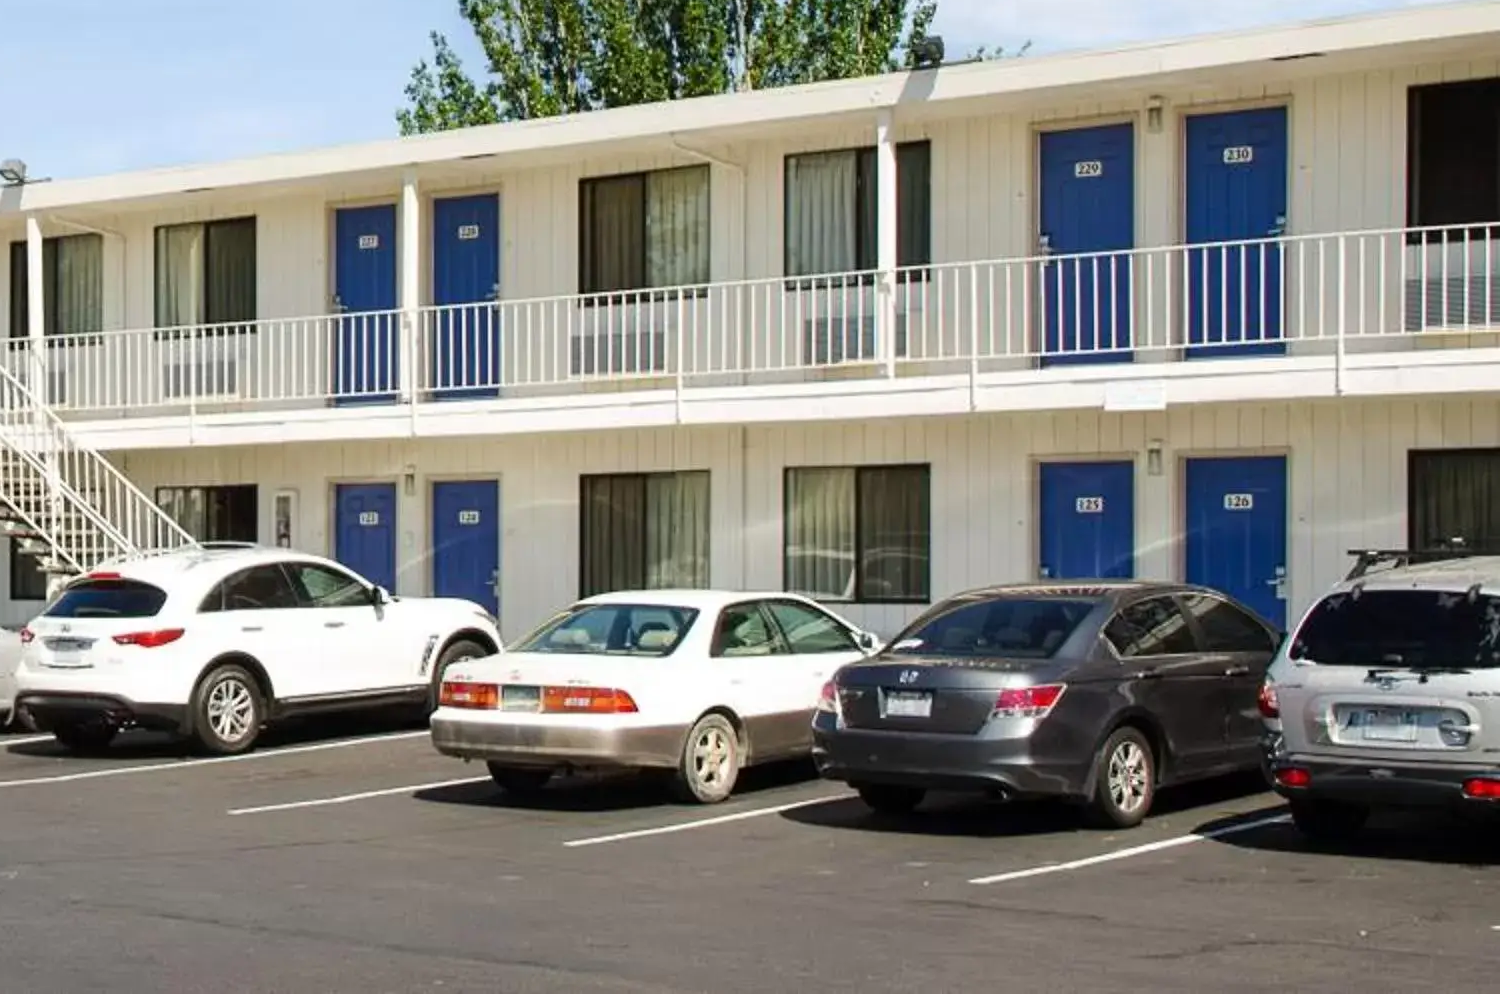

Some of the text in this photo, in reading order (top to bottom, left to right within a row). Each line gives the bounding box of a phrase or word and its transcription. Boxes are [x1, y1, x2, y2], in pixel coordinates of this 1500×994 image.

[1226, 148, 1250, 162] 230
[1077, 162, 1100, 175] 229
[1078, 498, 1101, 511] 125
[1227, 494, 1251, 508] 126
